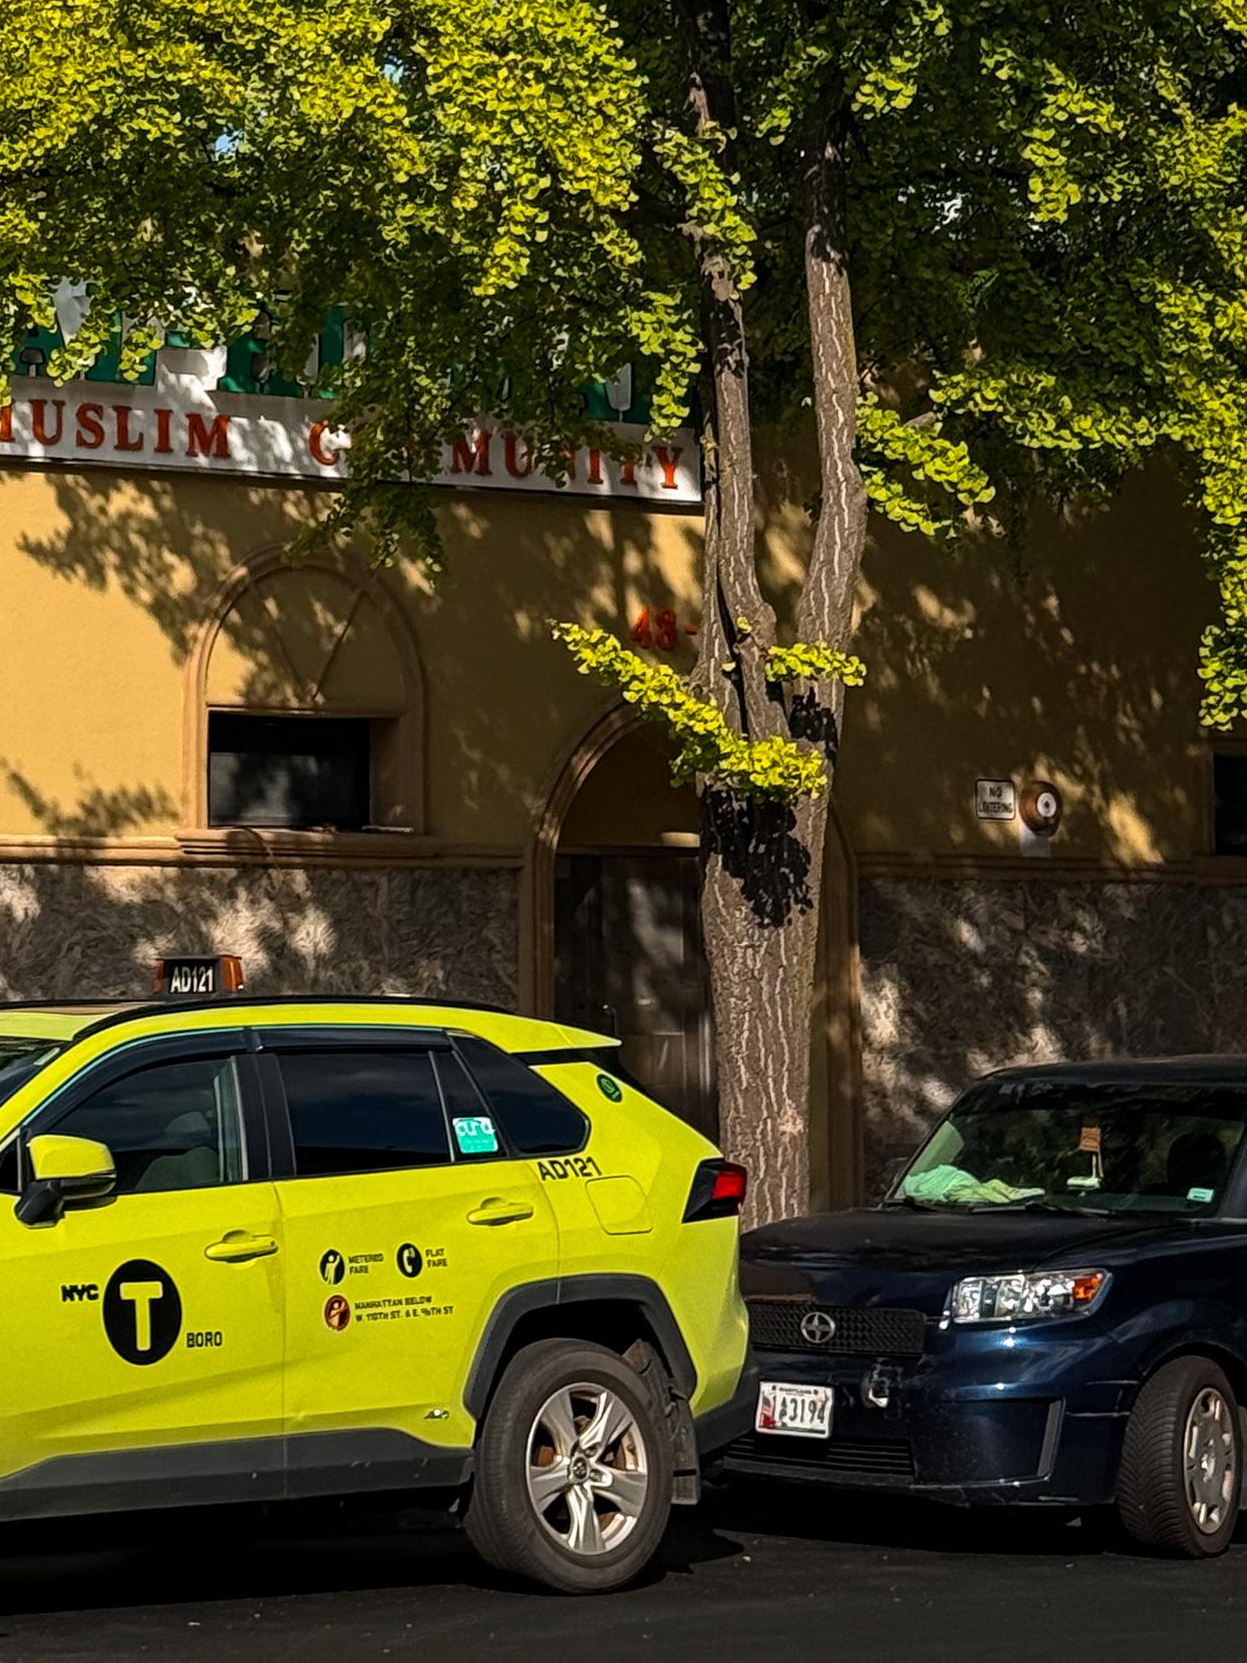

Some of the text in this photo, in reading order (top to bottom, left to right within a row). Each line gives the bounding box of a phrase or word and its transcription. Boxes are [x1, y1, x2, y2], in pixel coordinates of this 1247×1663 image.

[308, 417, 684, 489] CMUIY
[988, 786, 1003, 798] NO
[169, 965, 214, 993] AD121
[536, 1156, 603, 1182] AD121
[348, 1252, 384, 1264] METERED
[425, 1248, 445, 1258] FLAT
[349, 1265, 369, 1275] FARE
[427, 1258, 448, 1268] FARE
[61, 1284, 100, 1302] NYC
[354, 1295, 432, 1310] MANHATTAN BELOW
[119, 1281, 164, 1351] T
[186, 1331, 223, 1348] BORO
